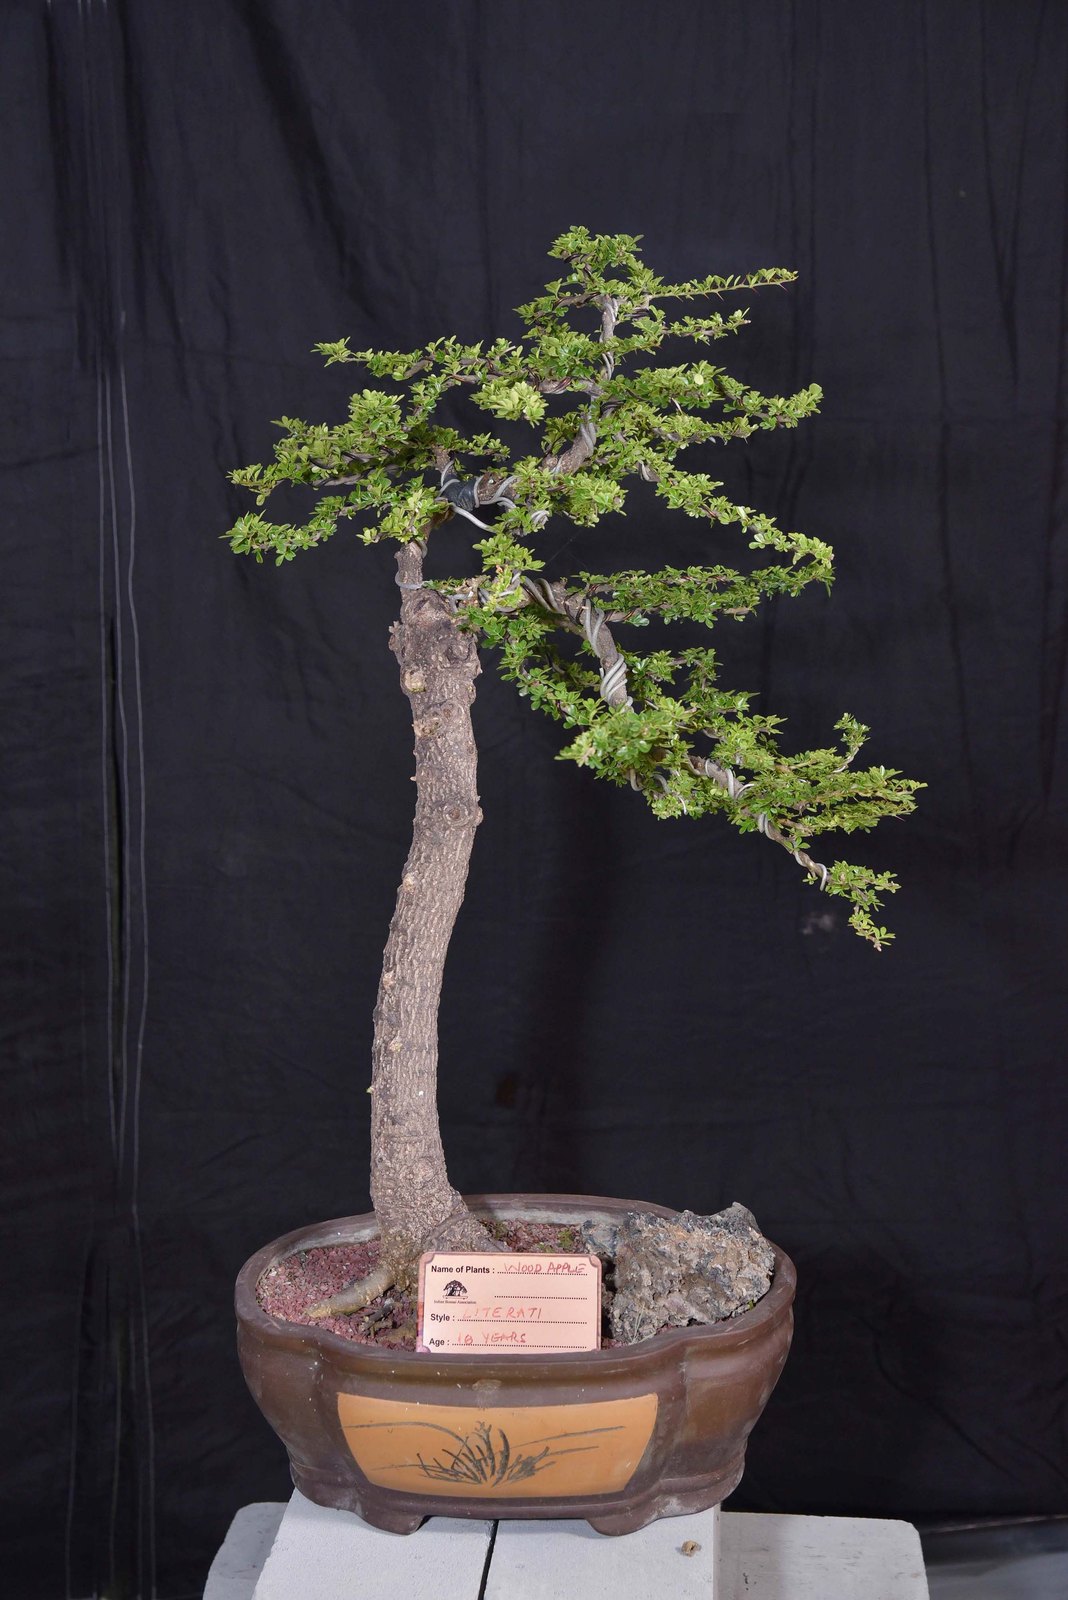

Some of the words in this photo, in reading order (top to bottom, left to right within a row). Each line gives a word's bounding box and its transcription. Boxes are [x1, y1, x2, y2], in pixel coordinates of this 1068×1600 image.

[431, 1265, 454, 1273] Name
[455, 1265, 465, 1273] of
[465, 1265, 490, 1274] Plants
[504, 1261, 542, 1272] WOOD
[547, 1262, 587, 1274] APPLE
[430, 1313, 450, 1323] Style
[463, 1307, 542, 1319] LITERATI
[429, 1337, 445, 1347] Age
[482, 1331, 526, 1344] YEARS
